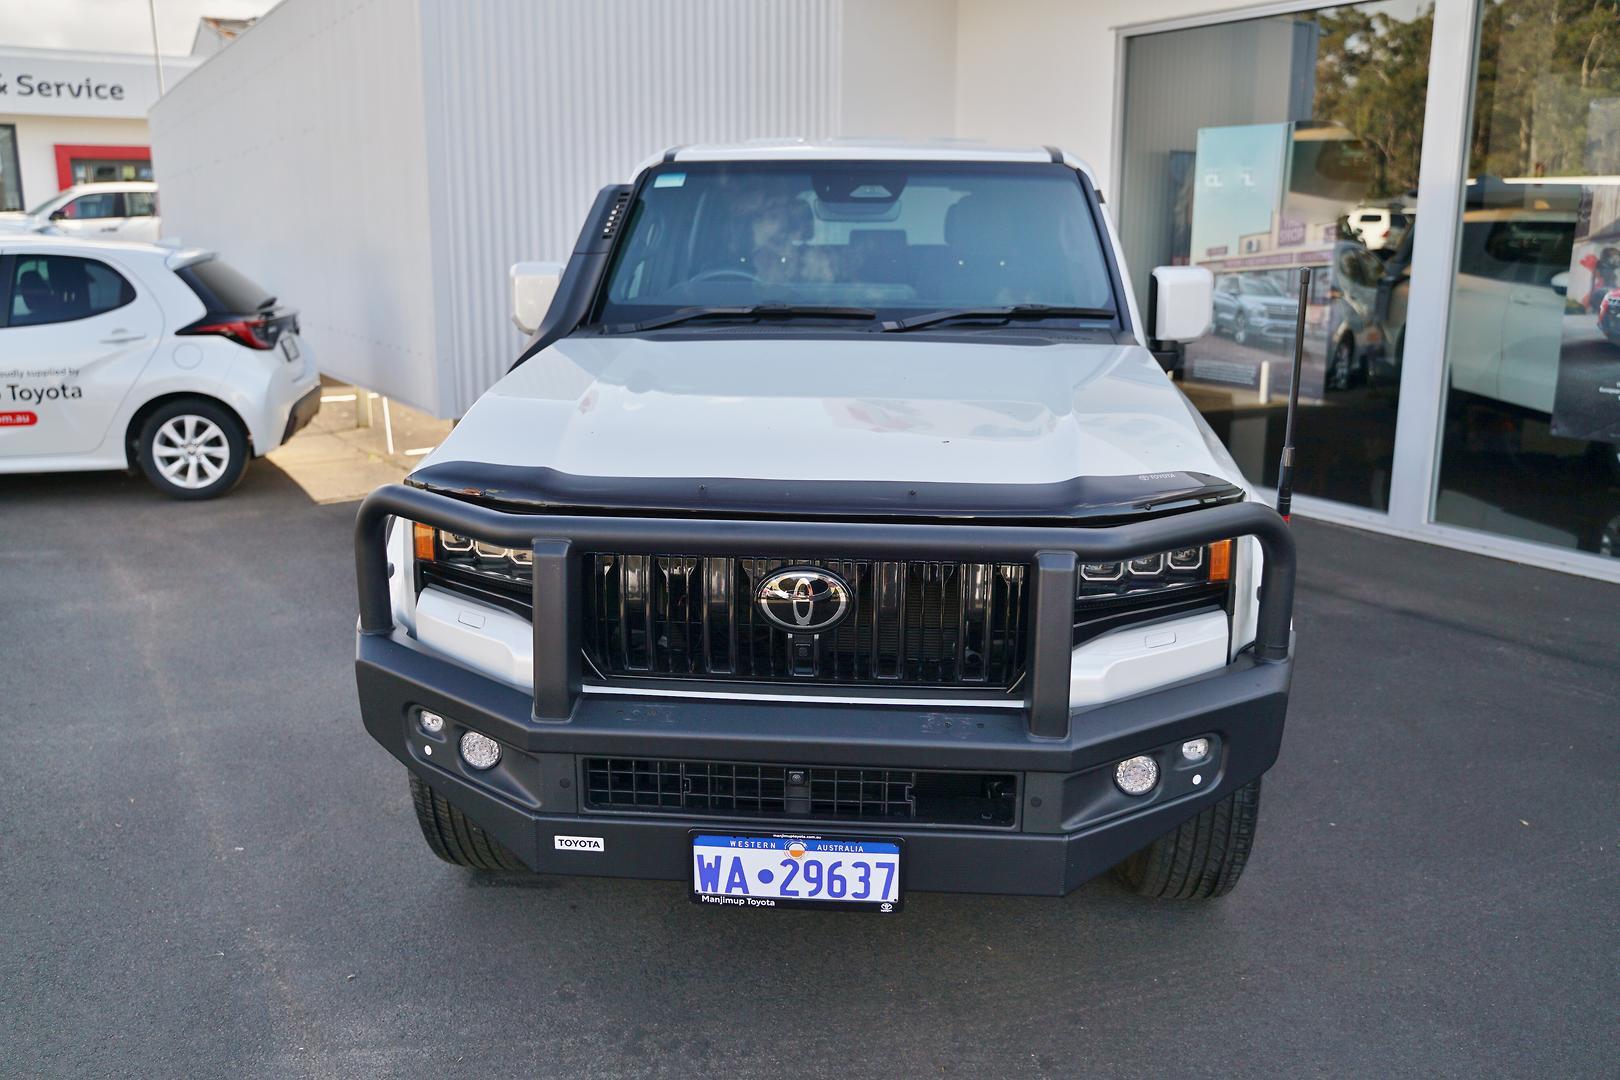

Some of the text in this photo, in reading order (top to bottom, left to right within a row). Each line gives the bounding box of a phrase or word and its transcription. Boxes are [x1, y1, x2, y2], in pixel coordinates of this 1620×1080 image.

[16, 74, 124, 101] Service
[6, 383, 83, 405] Toyota
[0, 414, 29, 424] m.au
[558, 839, 600, 848] TOYOTA
[729, 840, 864, 853] WESTERN AUSTRALIA
[701, 895, 776, 907] Manjimup Toyota
